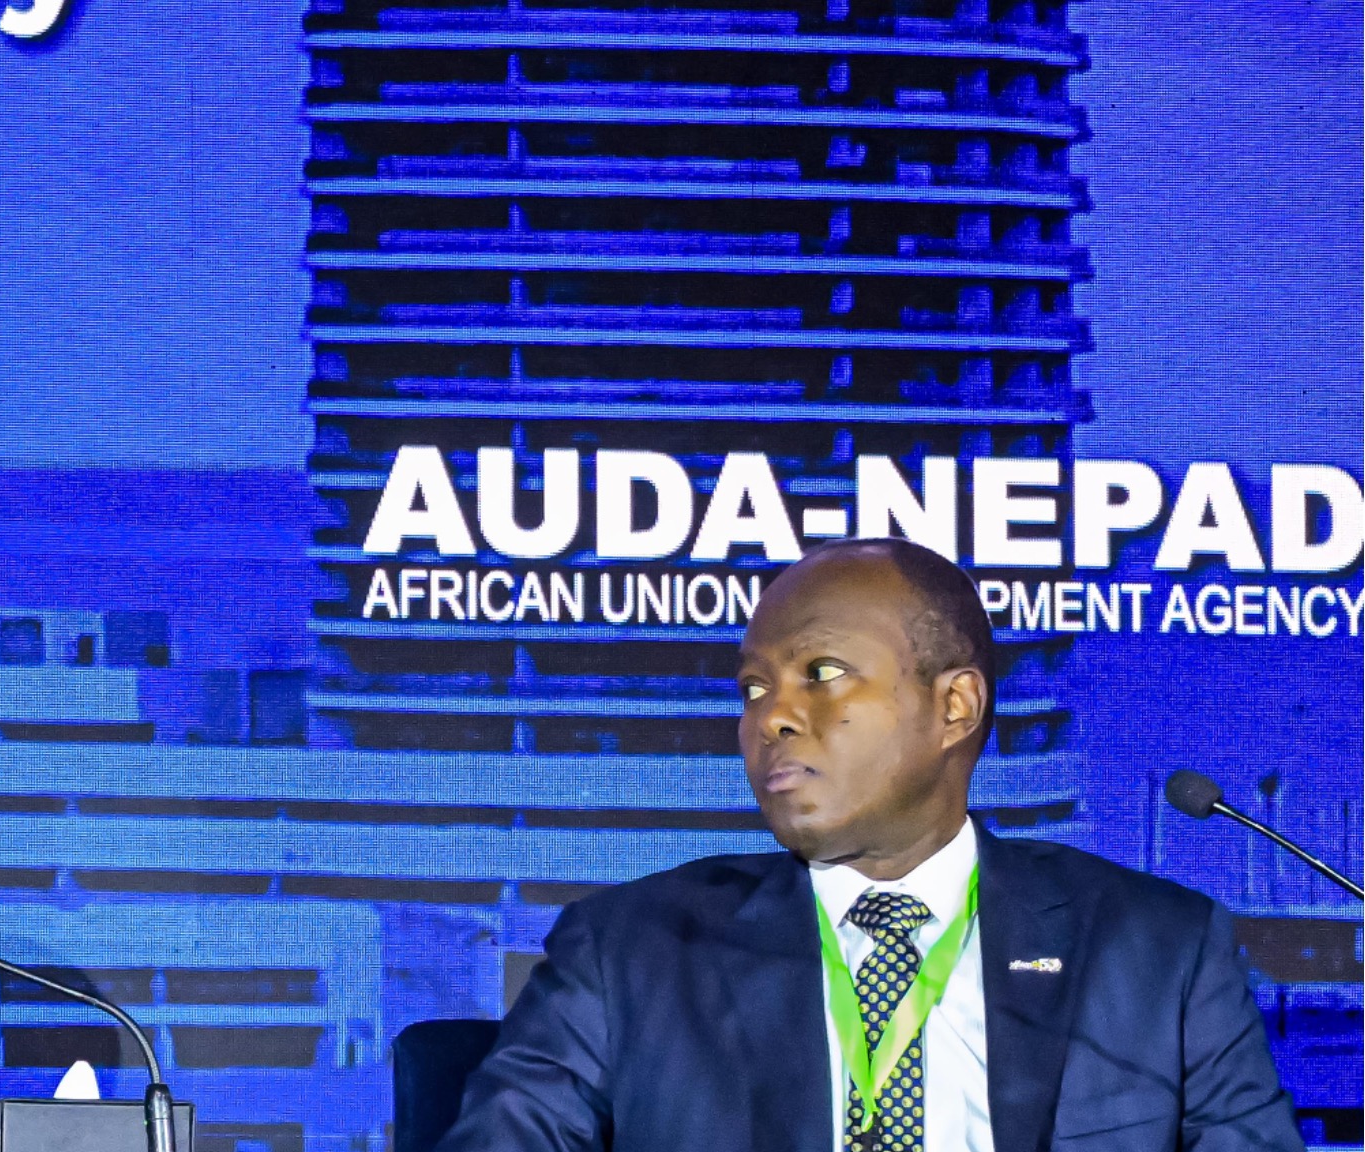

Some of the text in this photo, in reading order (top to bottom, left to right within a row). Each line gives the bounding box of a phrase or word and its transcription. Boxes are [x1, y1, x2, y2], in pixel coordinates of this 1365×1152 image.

[362, 445, 1364, 574] AUDA-NEPAD
[363, 568, 585, 623] AFRICAN
[600, 572, 760, 626] UNION
[1160, 583, 1364, 638] AGENCY
